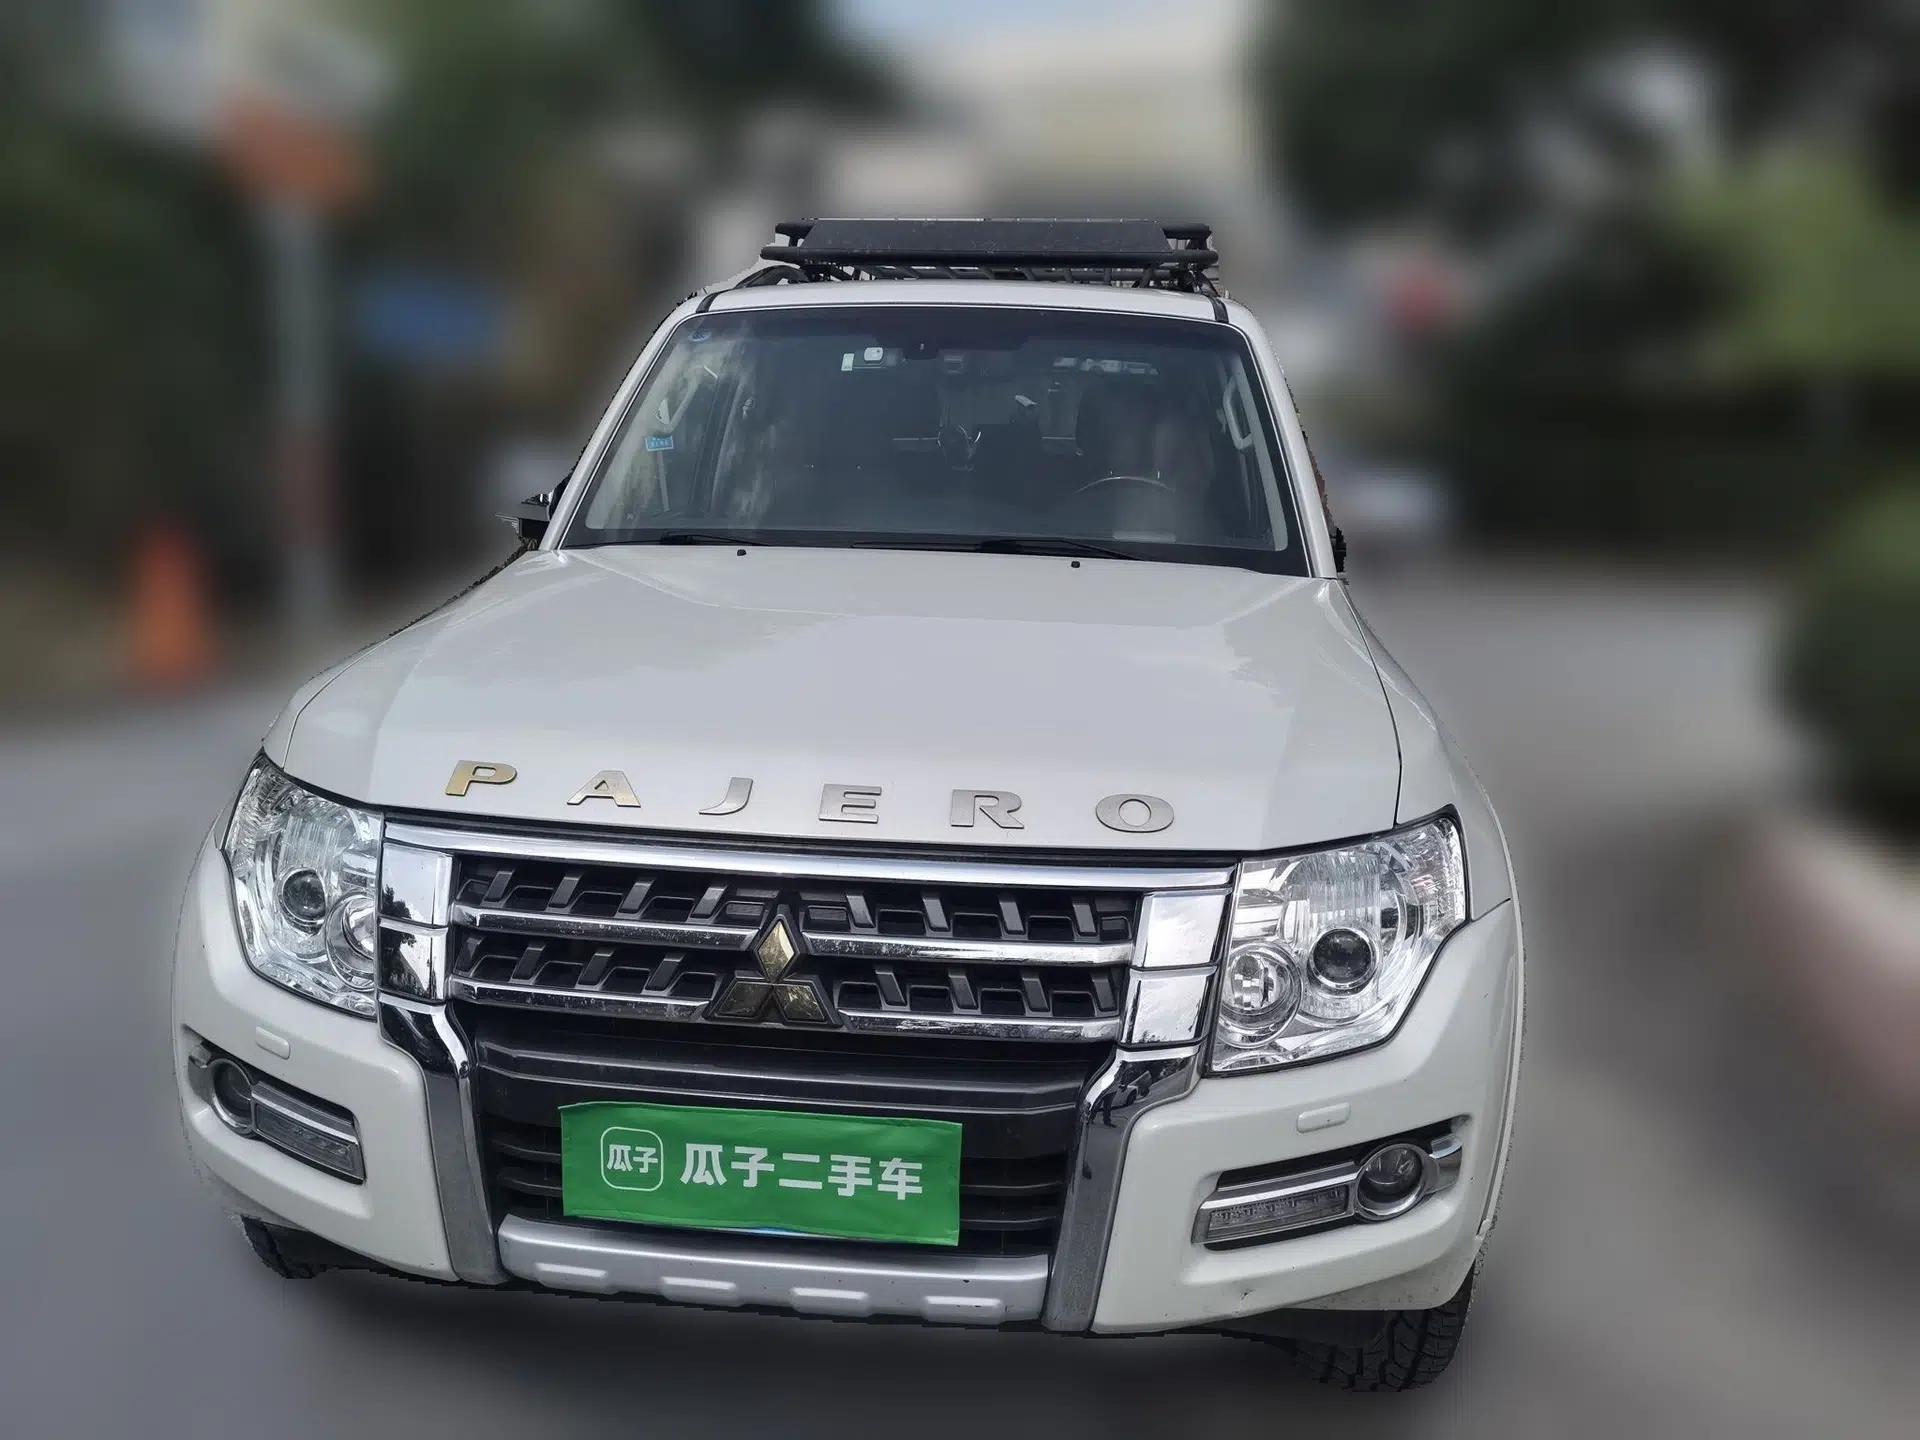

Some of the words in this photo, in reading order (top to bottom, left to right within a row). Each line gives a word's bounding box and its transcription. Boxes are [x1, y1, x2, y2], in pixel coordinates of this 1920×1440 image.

[445, 760, 1175, 833] PAJERO
[606, 1143, 659, 1174] 瓜子
[679, 1142, 923, 1200] 瓜子二手车
